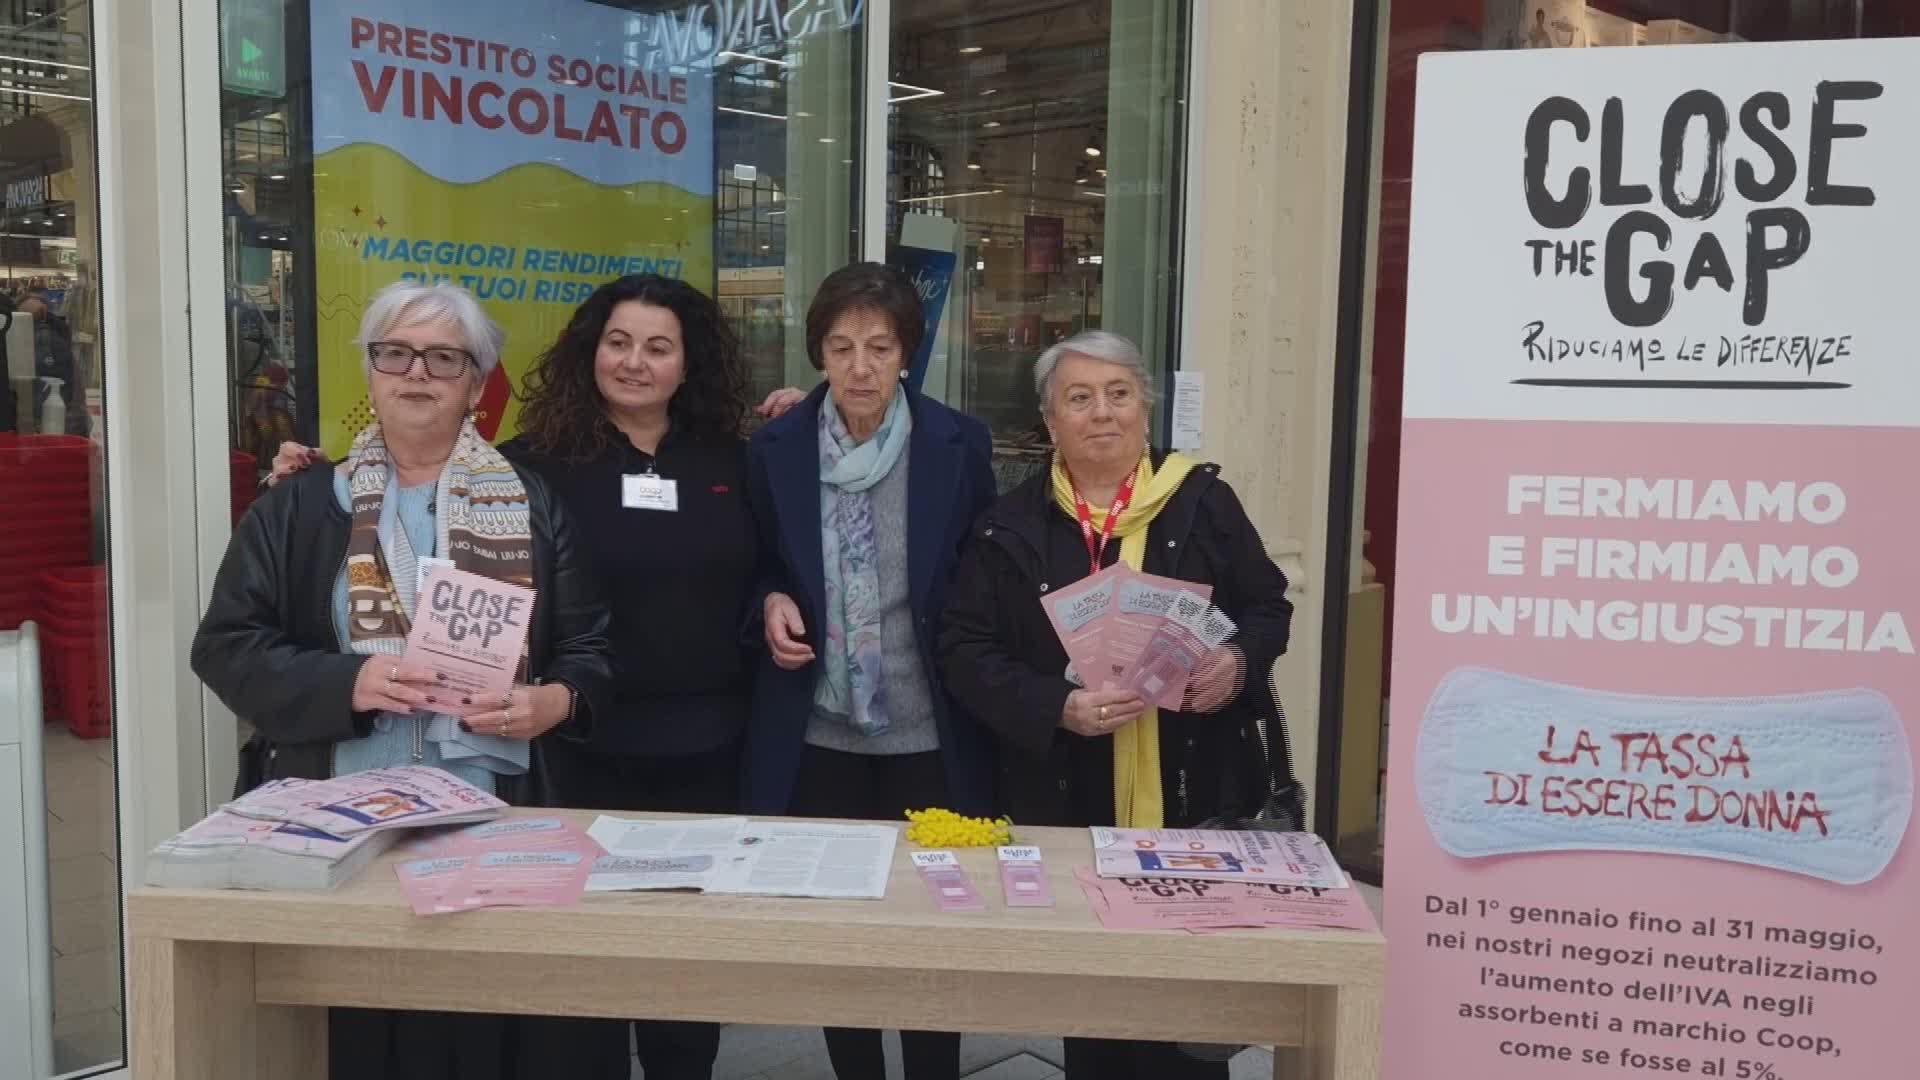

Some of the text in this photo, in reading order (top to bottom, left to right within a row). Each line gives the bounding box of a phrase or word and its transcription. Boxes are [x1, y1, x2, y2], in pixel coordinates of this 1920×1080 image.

[351, 17, 688, 105] PRESTITO SOCIALE
[352, 60, 687, 154] VINCOLATO
[1524, 80, 1884, 229] CLOSE
[362, 236, 516, 269] MAGGIORI
[523, 247, 683, 279] RENDIMENTI
[1524, 207, 1811, 328] THE GAP
[460, 275, 527, 300] TUOI
[1521, 320, 1852, 376] RIDUCIAMO LE DIFFERENZE
[1508, 475, 1847, 524] FERMIAMO
[1488, 535, 1859, 588] E FIRMIAMO
[431, 580, 527, 627] CLOSE
[448, 611, 503, 648] GAP
[1430, 593, 1915, 654] UN'INGIUSTIZIA
[1538, 725, 1750, 778] LA TASSA
[1483, 770, 1832, 836] DI ESSERE DONNA
[1150, 884, 1210, 897] GAP
[1425, 895, 1884, 955] Dal 1° gennaio fino al 31 maggio,
[1426, 931, 1877, 986] nei nostri negozi neutralizziamo
[1480, 966, 1814, 1017] l'aumento dell'IVA negli
[1458, 1001, 1841, 1057] assorbenti a marchio Coop,
[1499, 1040, 1572, 1062] come
[1582, 1048, 1610, 1065] se
[1619, 1047, 1692, 1073] fosse
[1701, 1056, 1725, 1077] al
